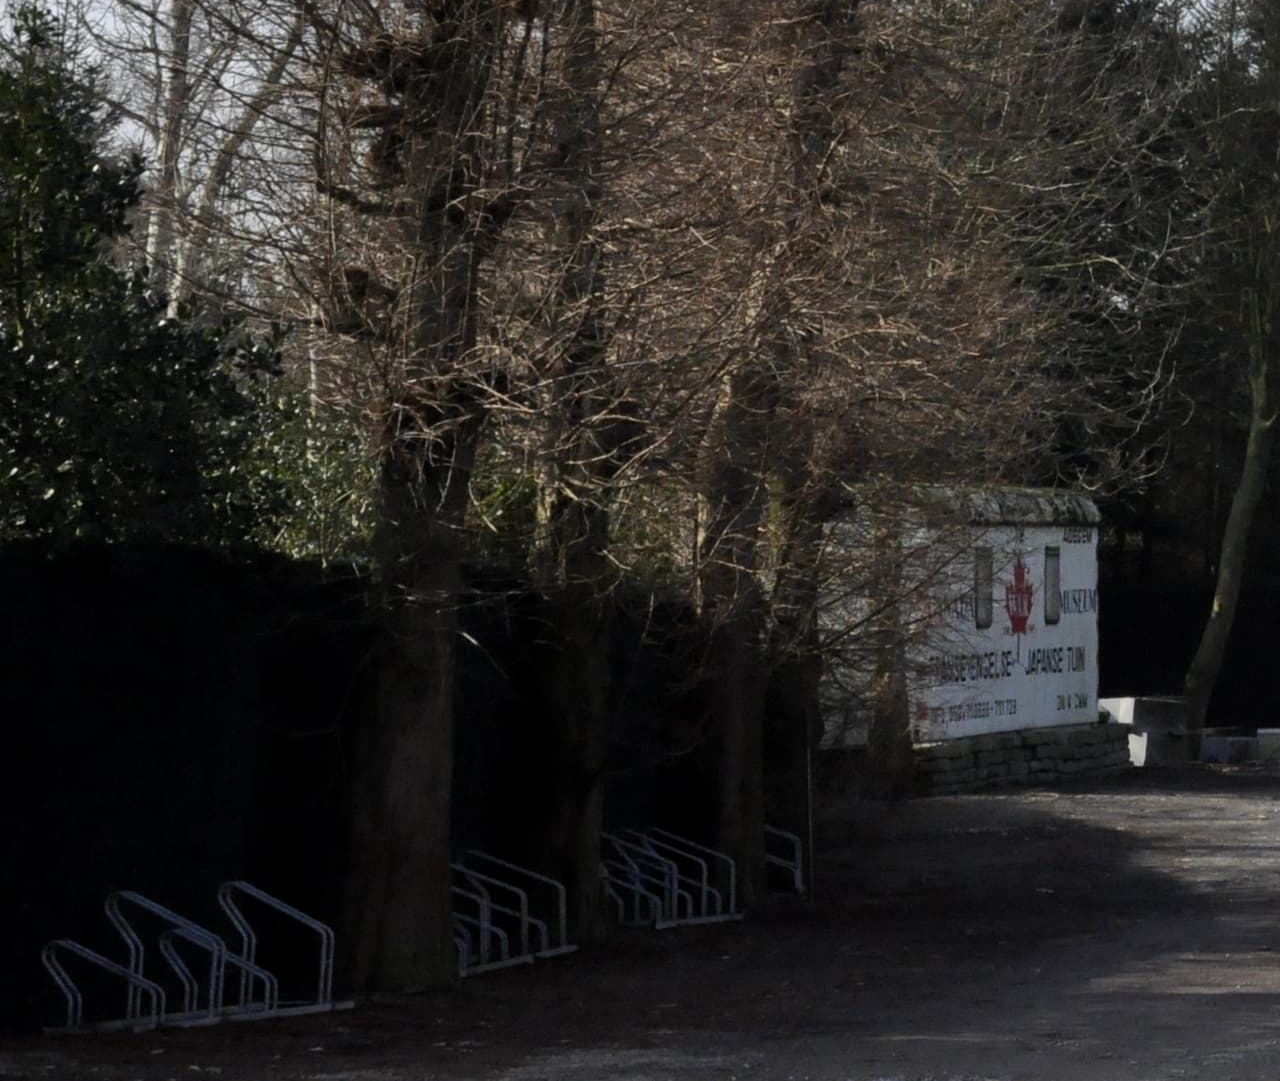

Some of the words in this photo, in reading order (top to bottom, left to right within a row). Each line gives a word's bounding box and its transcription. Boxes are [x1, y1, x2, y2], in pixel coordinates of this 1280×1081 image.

[1060, 589, 1097, 614] MUSEUM
[1025, 647, 1063, 675] JAPANSE
[1066, 647, 1086, 672] TUIN
